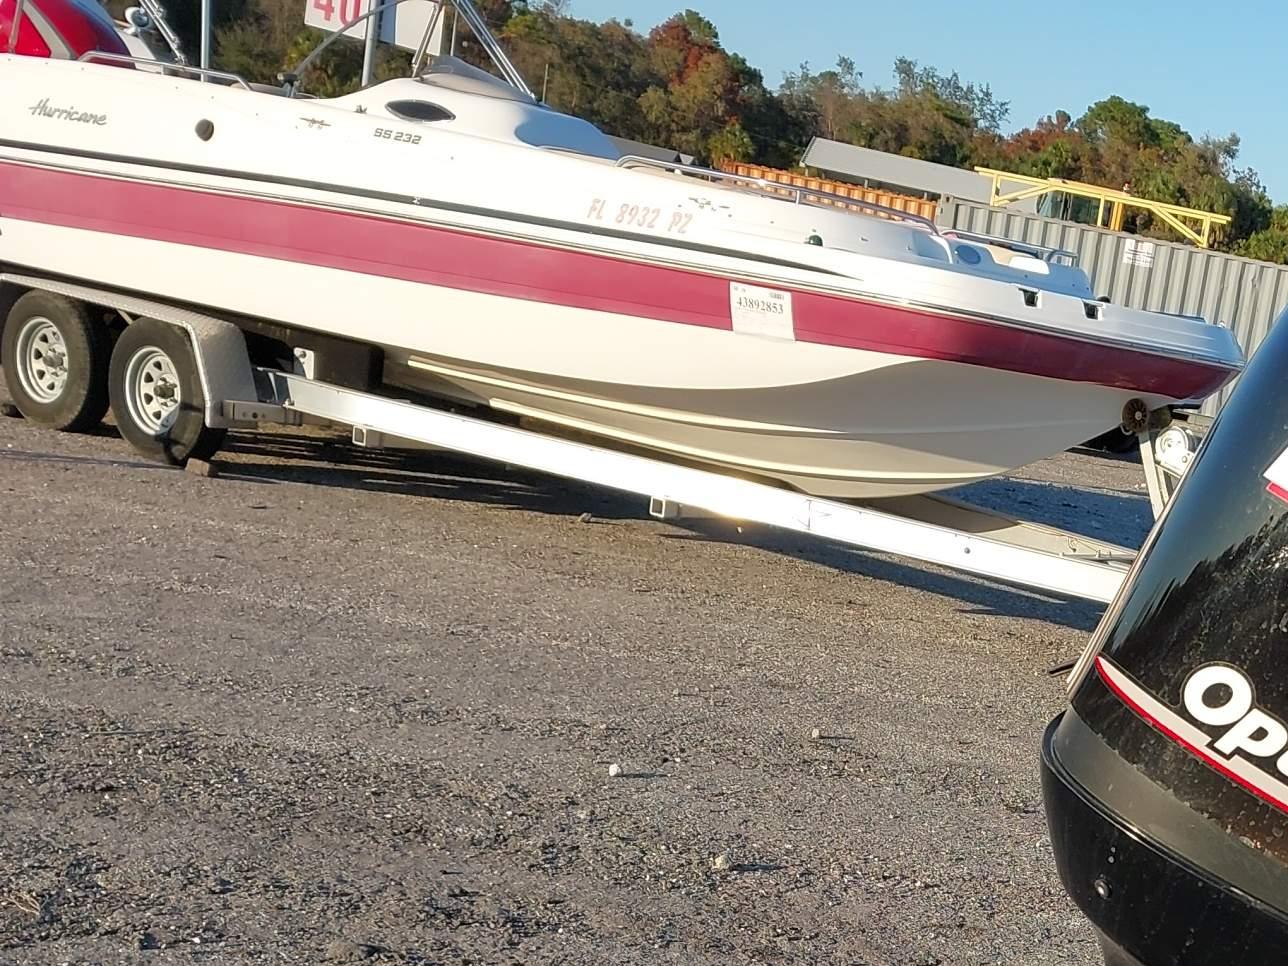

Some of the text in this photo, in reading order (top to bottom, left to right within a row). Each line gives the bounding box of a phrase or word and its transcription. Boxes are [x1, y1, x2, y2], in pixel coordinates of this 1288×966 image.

[28, 97, 108, 126] Hurricane
[373, 127, 422, 145] SS 232
[587, 198, 606, 220] FL
[615, 203, 661, 229] 8932
[736, 297, 784, 315] 43892853
